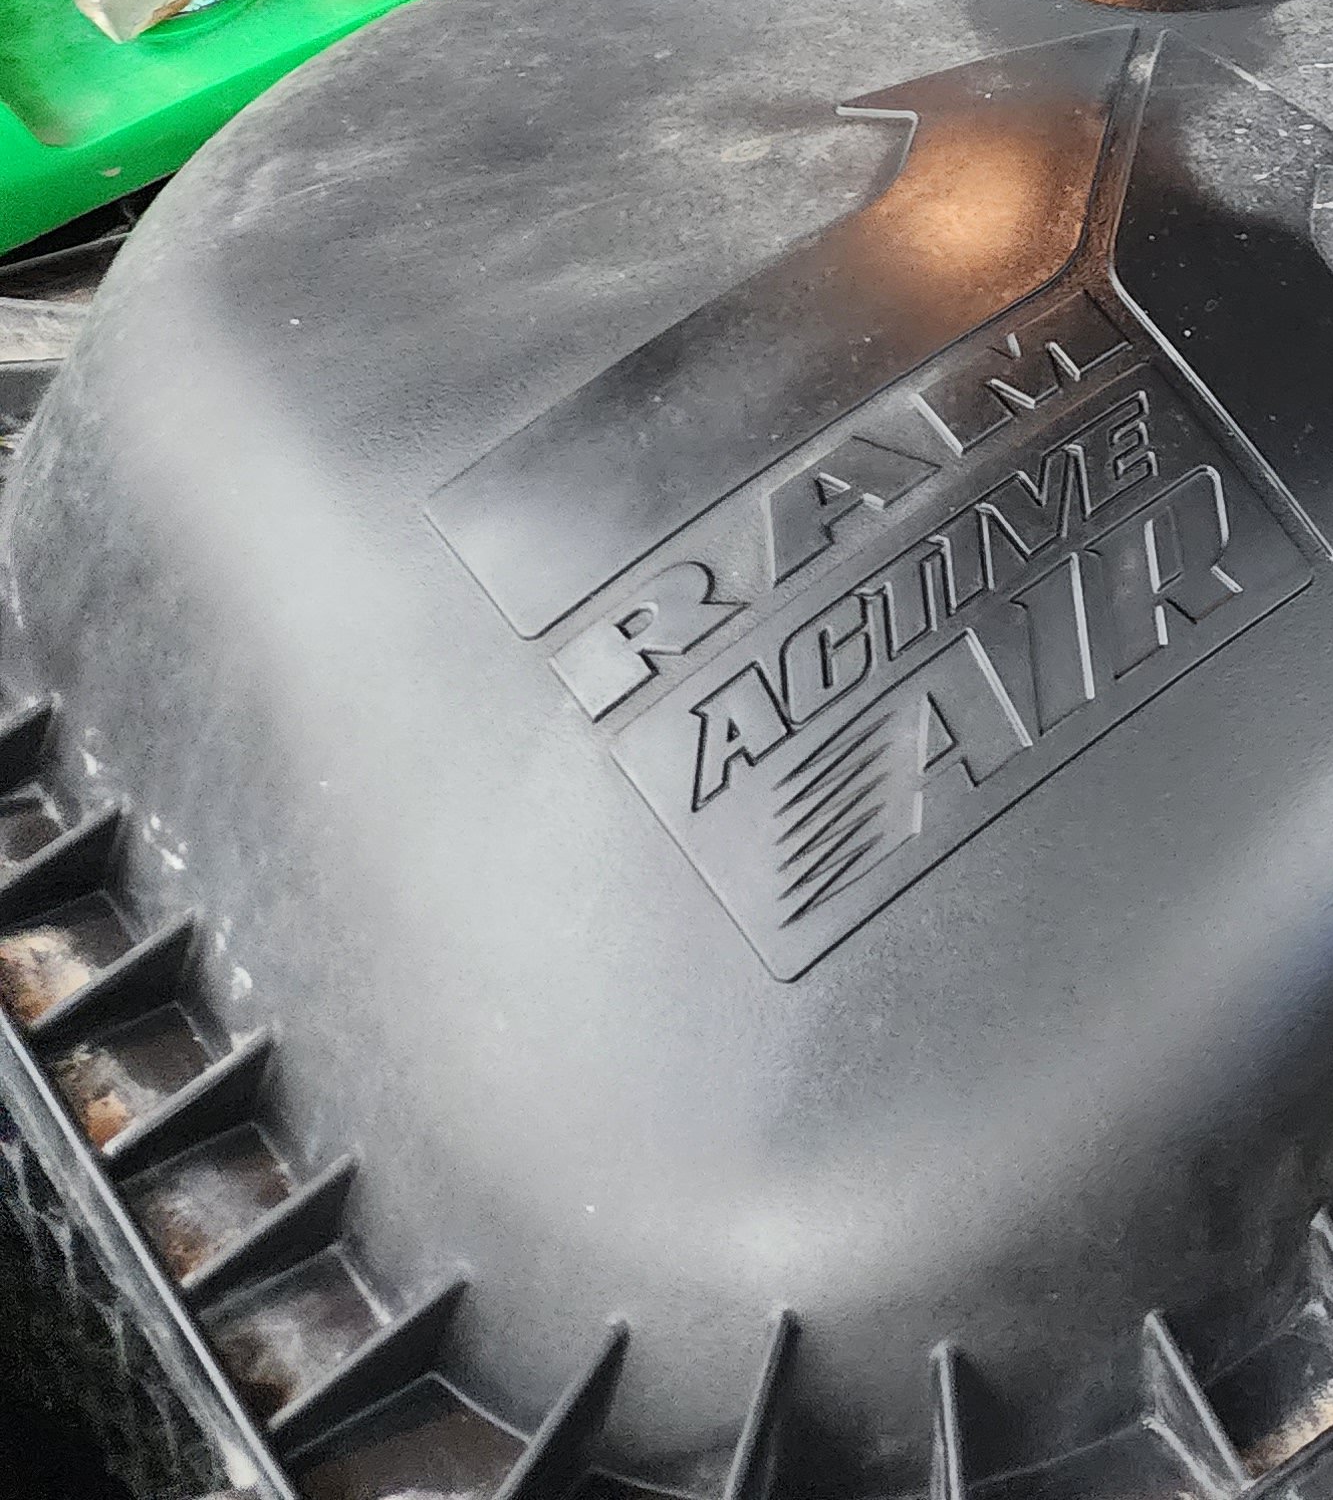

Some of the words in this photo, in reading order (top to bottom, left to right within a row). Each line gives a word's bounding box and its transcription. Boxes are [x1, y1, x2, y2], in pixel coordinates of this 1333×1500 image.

[550, 289, 1136, 722] RAM
[692, 390, 1161, 812] ACTIVE
[785, 465, 1243, 925] AIR
